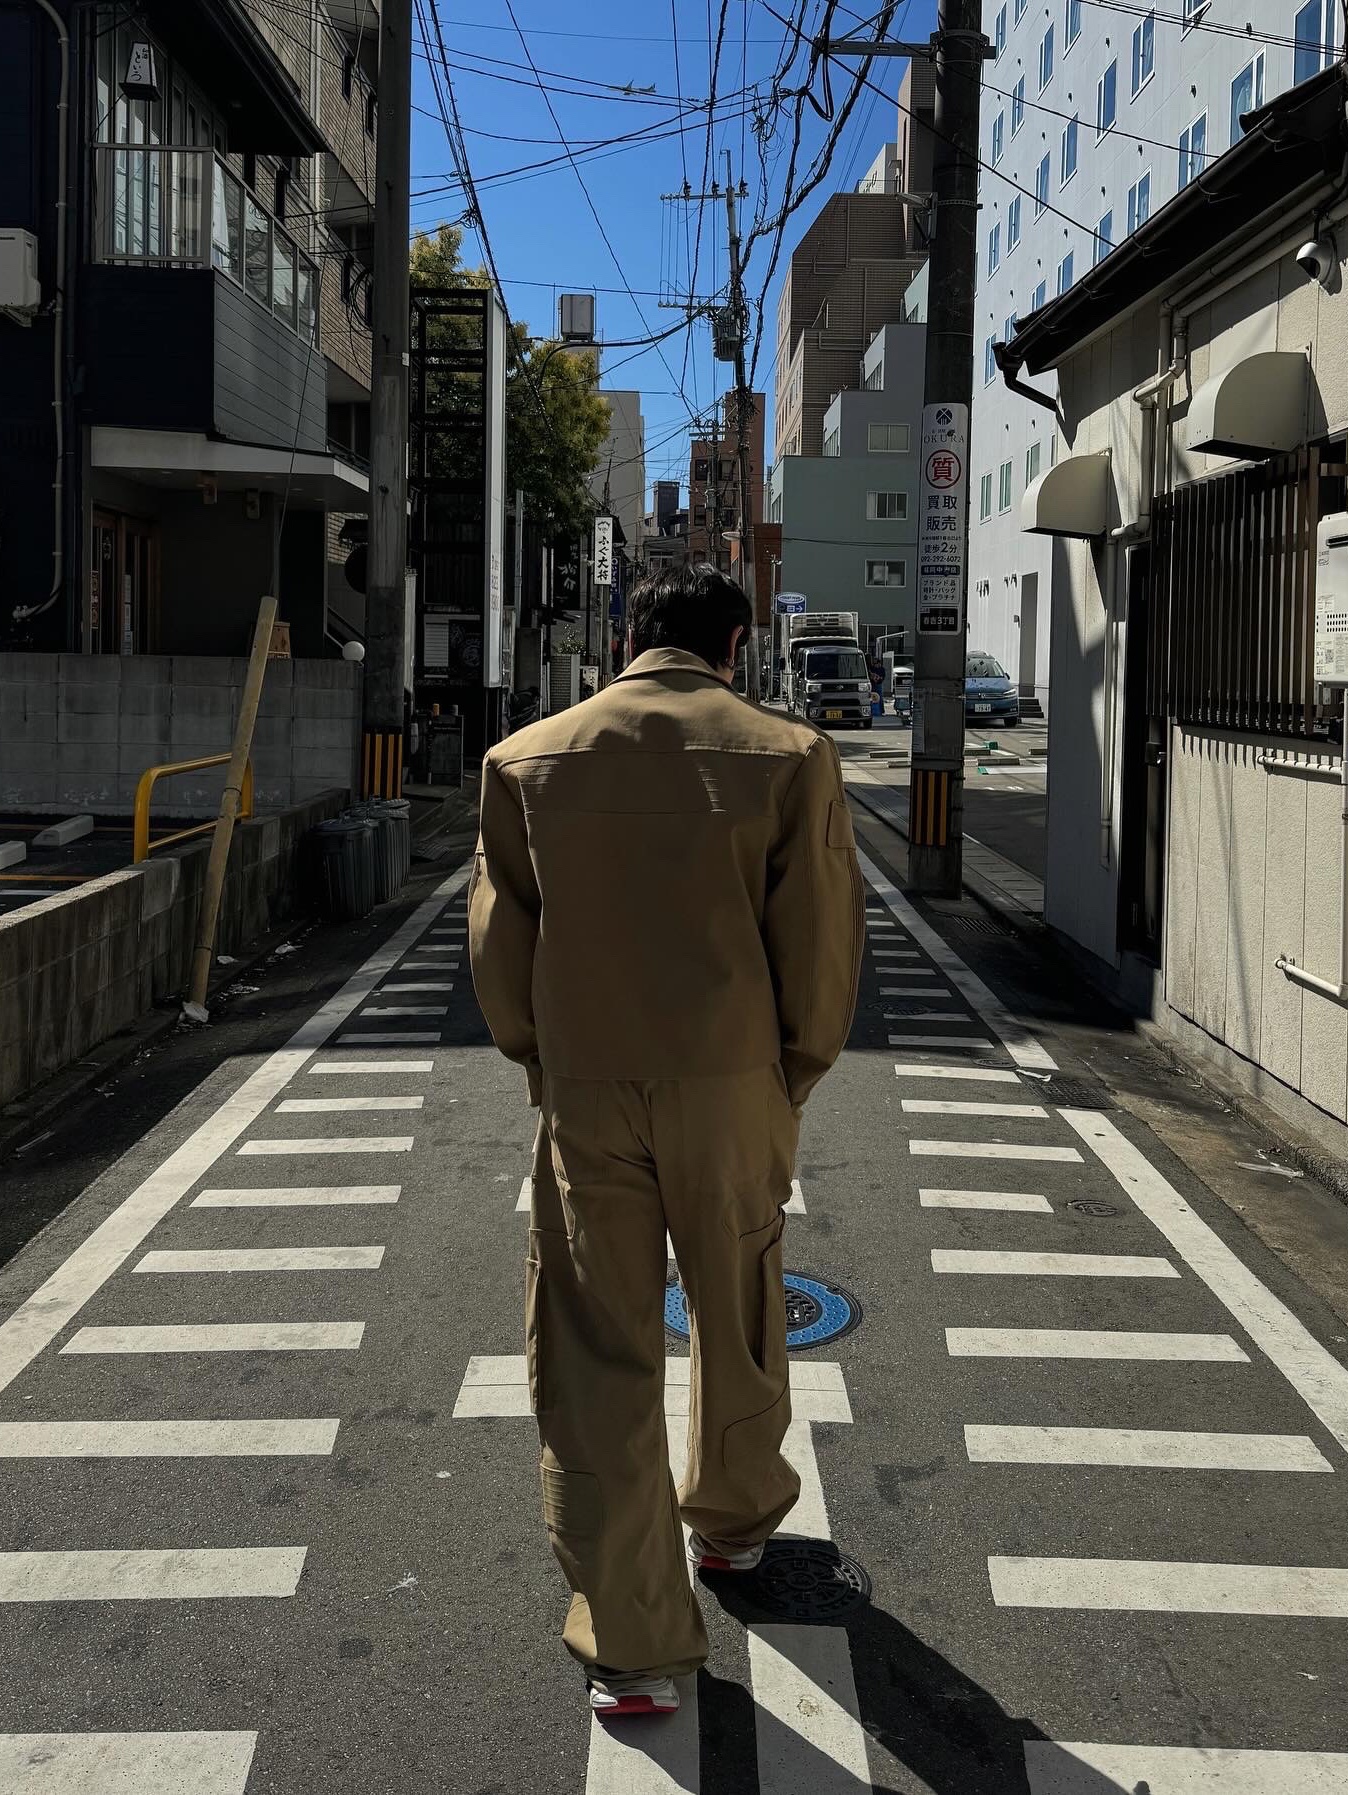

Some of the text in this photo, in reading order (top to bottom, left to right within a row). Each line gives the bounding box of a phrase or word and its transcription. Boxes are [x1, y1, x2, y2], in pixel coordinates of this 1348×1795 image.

[932, 457, 954, 481] 質
[928, 495, 957, 510] 買取
[926, 515, 956, 531] 販売
[924, 542, 957, 553] 徒歩2分
